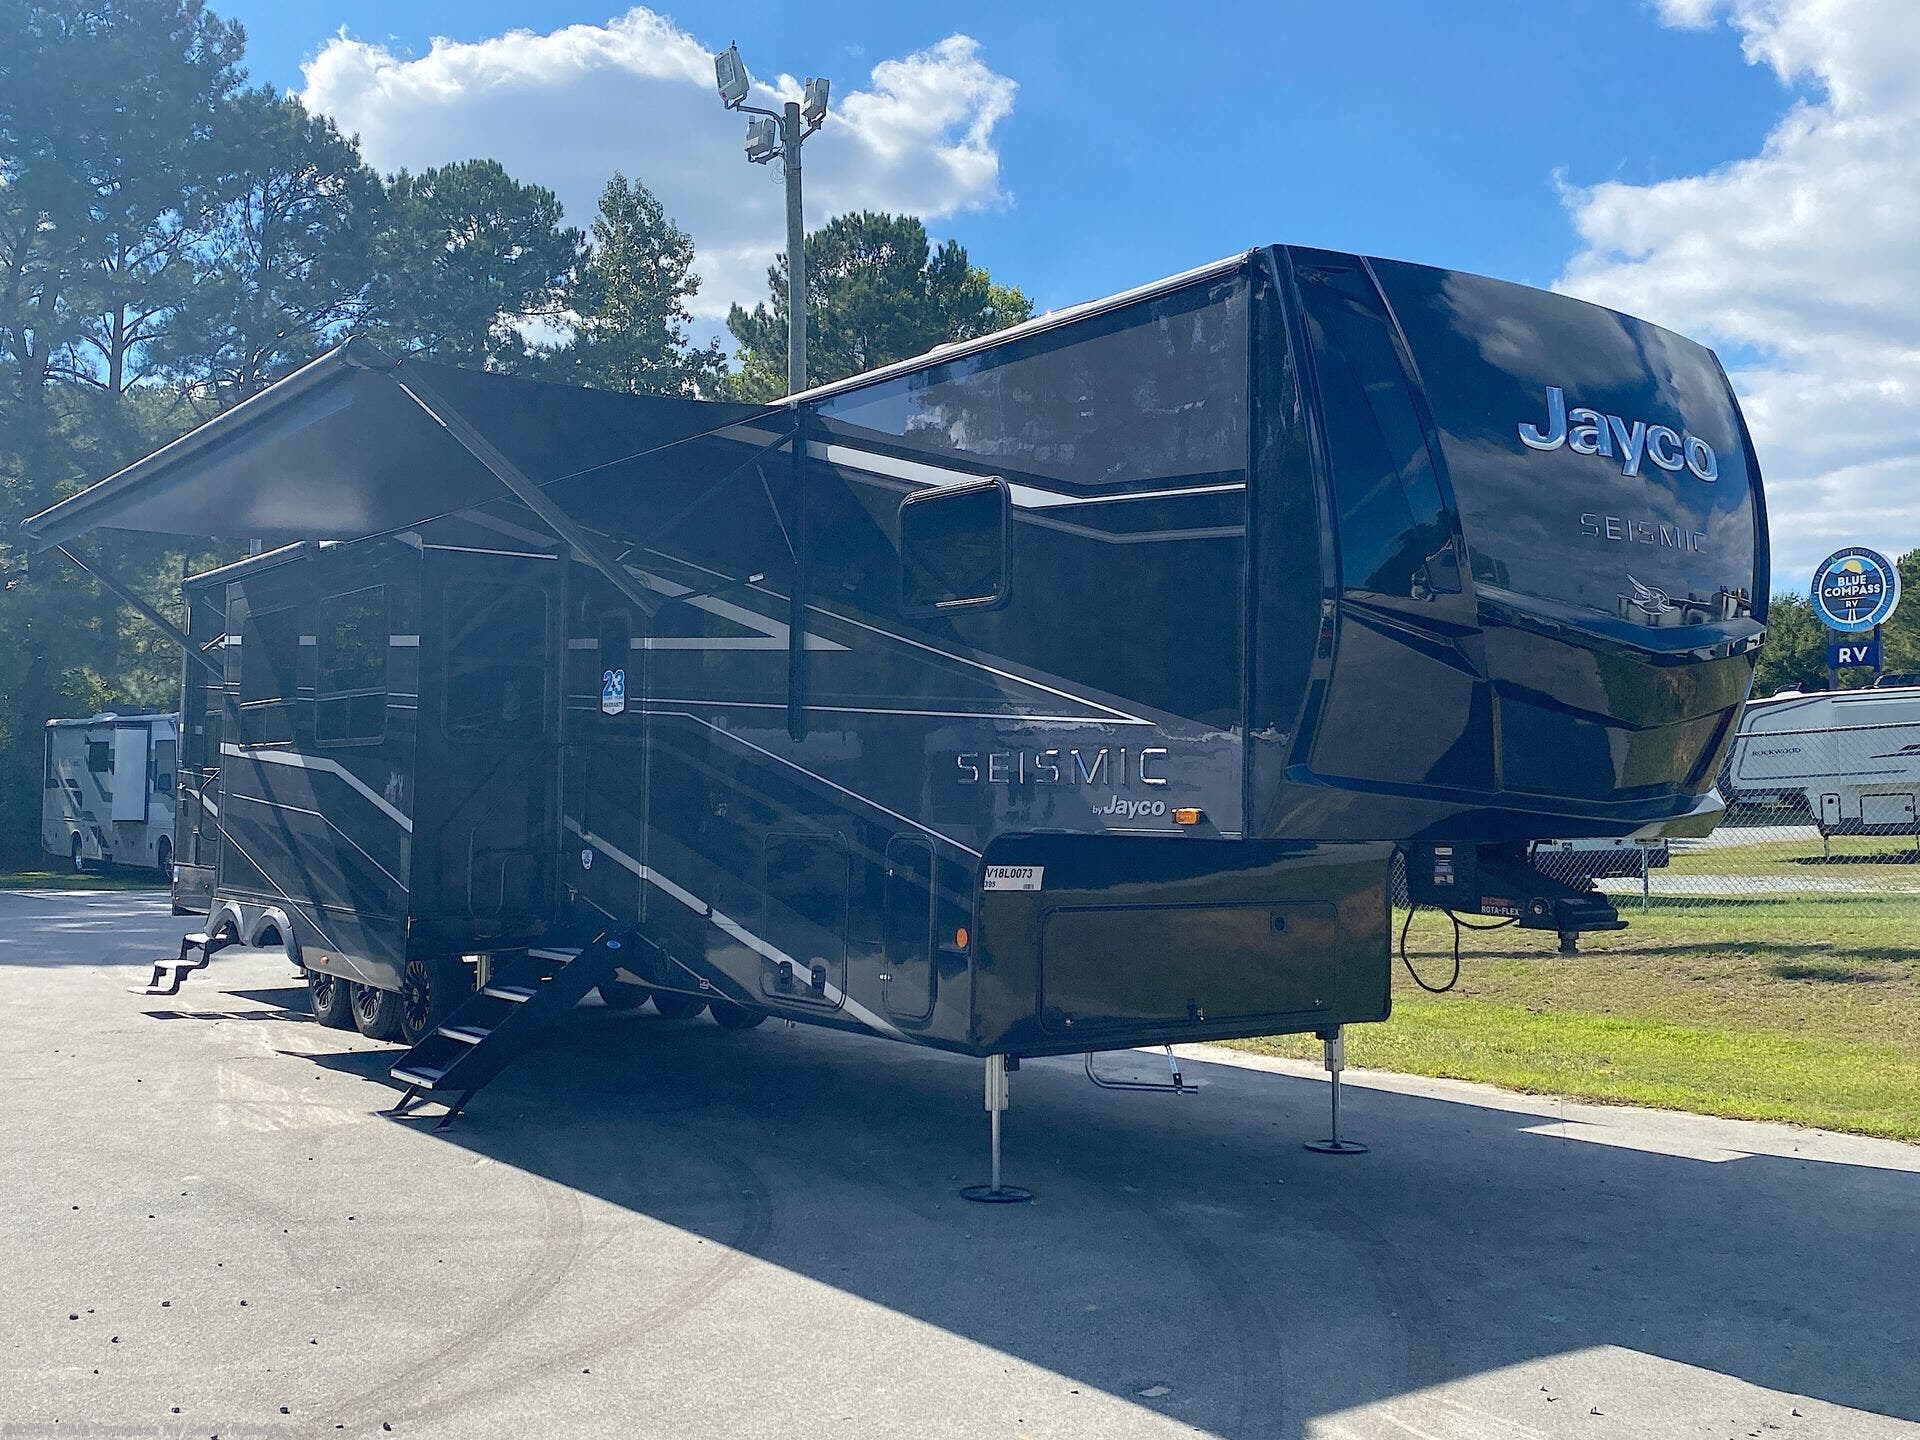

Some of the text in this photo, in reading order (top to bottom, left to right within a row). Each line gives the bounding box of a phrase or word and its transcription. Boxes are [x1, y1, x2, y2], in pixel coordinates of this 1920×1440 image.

[1518, 386, 1718, 482] Jayco
[1580, 512, 1708, 554] SEISMIC
[1838, 575, 1867, 586] BLUE
[1824, 584, 1881, 597] COMPASS
[1845, 600, 1859, 608] RV
[1838, 646, 1868, 663] RV
[1752, 747, 1802, 756] ROCKWOOD
[957, 747, 1168, 785] SEISMIC
[1092, 795, 1166, 819] by Jayco
[1481, 905, 1520, 916] ROTA-FLEX
